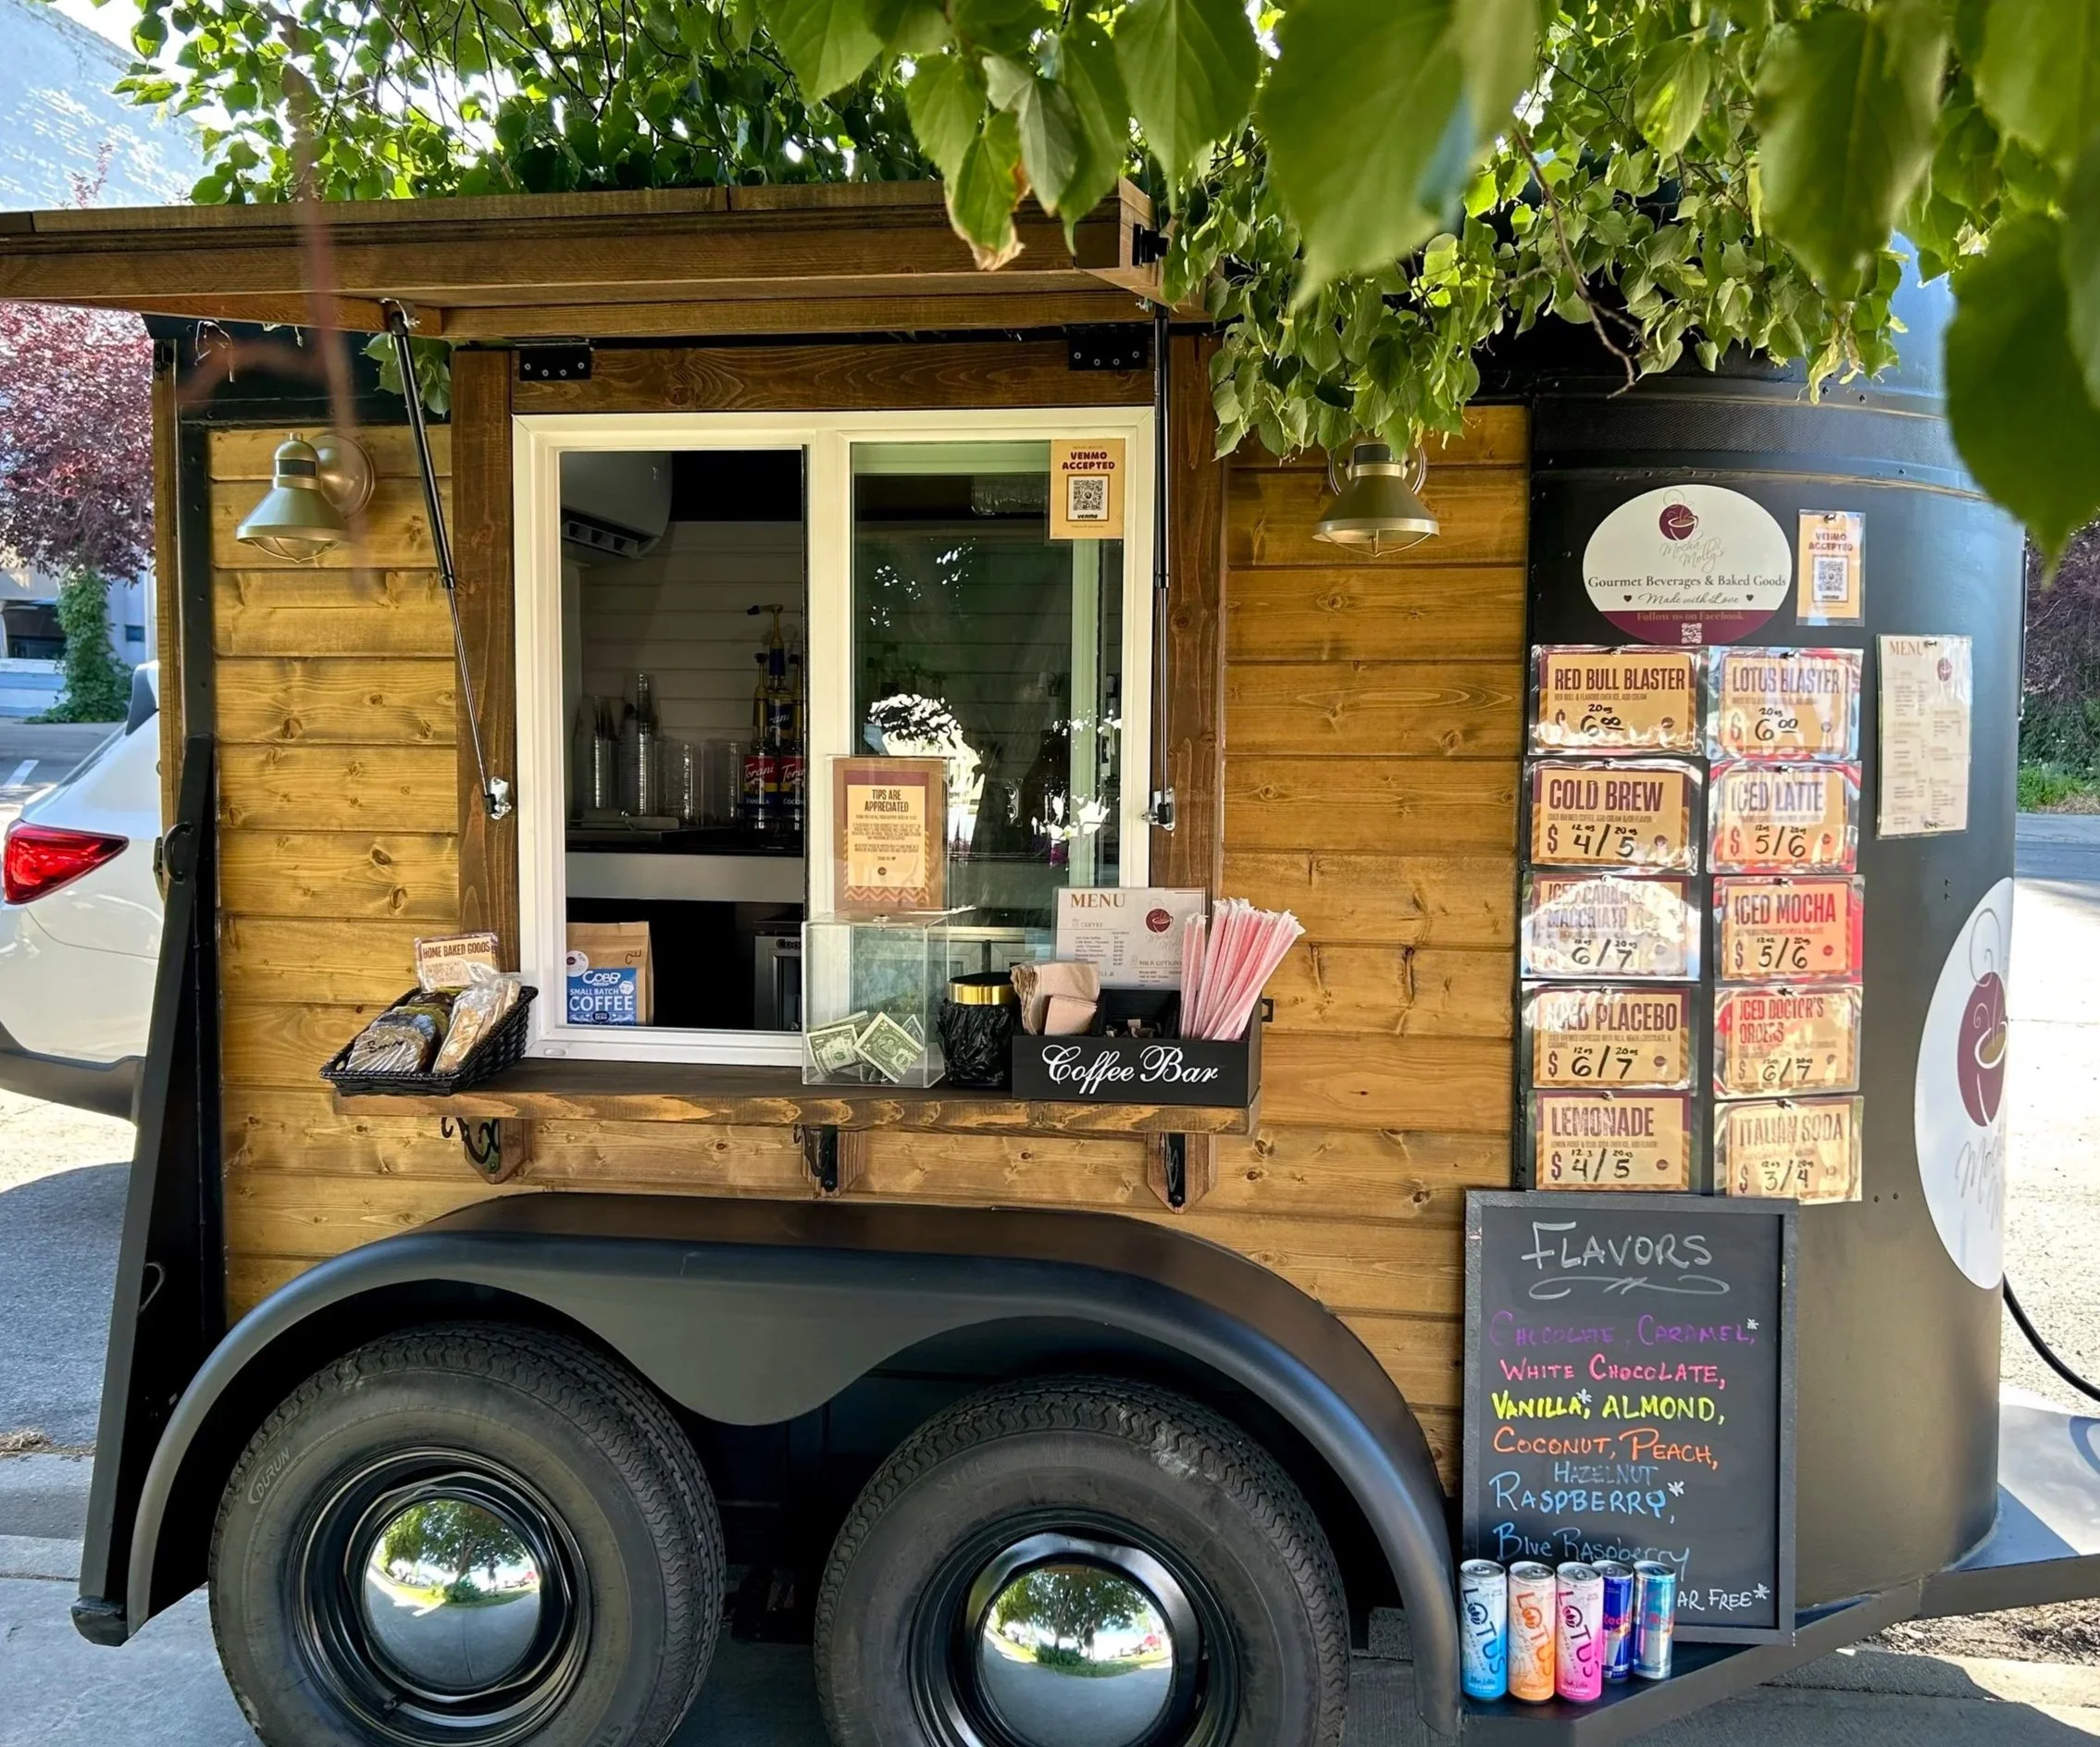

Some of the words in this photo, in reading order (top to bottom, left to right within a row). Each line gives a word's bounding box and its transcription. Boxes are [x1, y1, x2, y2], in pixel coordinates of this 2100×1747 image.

[1062, 461, 1115, 470] ACCEPTED
[1070, 452, 1108, 460] VENMO
[1808, 541, 1854, 551] ACCEPTED
[1815, 532, 1847, 541] VENMO
[1588, 576, 1642, 588] Gourmet
[1646, 576, 1701, 589] Beverages
[1704, 576, 1714, 587] &
[1718, 574, 1750, 587] Baked
[1753, 575, 1786, 587] Goods
[1638, 592, 1680, 605] Made
[1682, 594, 1707, 604] with
[1707, 592, 1740, 605] Love
[1636, 612, 1670, 621] Follow
[1671, 613, 1684, 621] us
[1684, 613, 1697, 621] on
[1698, 611, 1744, 621] Facebook
[1889, 640, 1924, 656] MENU
[1554, 668, 1581, 690] RED
[1585, 668, 1620, 690] BULL
[1623, 668, 1685, 690] BLASTER
[1733, 666, 1776, 693] LOTUS
[1781, 667, 1840, 694] BLASTER
[743, 762, 776, 782] Torani
[781, 763, 806, 782] Tora
[864, 801, 909, 812] APPRECIATED
[872, 789, 887, 800] TIPS
[888, 789, 901, 800] ARE
[1548, 778, 1599, 811] COLD
[1605, 780, 1664, 812] BREW
[1731, 780, 1769, 812] ICED
[1774, 781, 1823, 812] LATTE
[1547, 824, 1558, 854] $
[1730, 826, 1740, 856] $
[1070, 893, 1126, 909] MENU
[1734, 895, 1771, 925] ICED
[1776, 893, 1836, 924] MOCHA
[423, 946, 442, 960] HOME
[443, 944, 466, 957] BAKED
[467, 941, 491, 955] GOODS
[1734, 939, 1744, 970] $
[569, 987, 593, 996] SMALL
[594, 987, 619, 996] BATCH
[569, 996, 634, 1011] COFFEE
[1596, 1002, 1678, 1032] PLACEBO
[1739, 999, 1765, 1021] ICED
[1769, 997, 1824, 1019] DOCTOR'S
[1739, 1022, 1784, 1044] ORDERS
[1041, 1044, 1135, 1095] Coffee
[1139, 1045, 1218, 1084] Bar
[1547, 1050, 1558, 1077] $
[1738, 1059, 1746, 1081] $
[1551, 1106, 1655, 1137] LEMONADE
[1739, 1113, 1797, 1147] ITALIAN
[1801, 1112, 1843, 1142] SODA
[1551, 1151, 1561, 1181] $
[1739, 1164, 1748, 1194] $
[1521, 1220, 1712, 1270] FLAVORS
[1499, 1357, 1575, 1381] WHITE
[1588, 1353, 1726, 1389] CHOCOLATE,
[1601, 1394, 1725, 1425] ALMOND,
[1493, 1426, 1616, 1460] COCONUT,
[1619, 1428, 1719, 1470] PEACH,
[1554, 1460, 1659, 1486] HAZELNUT
[1492, 1522, 1553, 1561] Blue
[1462, 1587, 1506, 1676] LOTUS
[1515, 1591, 1554, 1677] LOTUS
[1557, 1591, 1599, 1678] LOTUS
